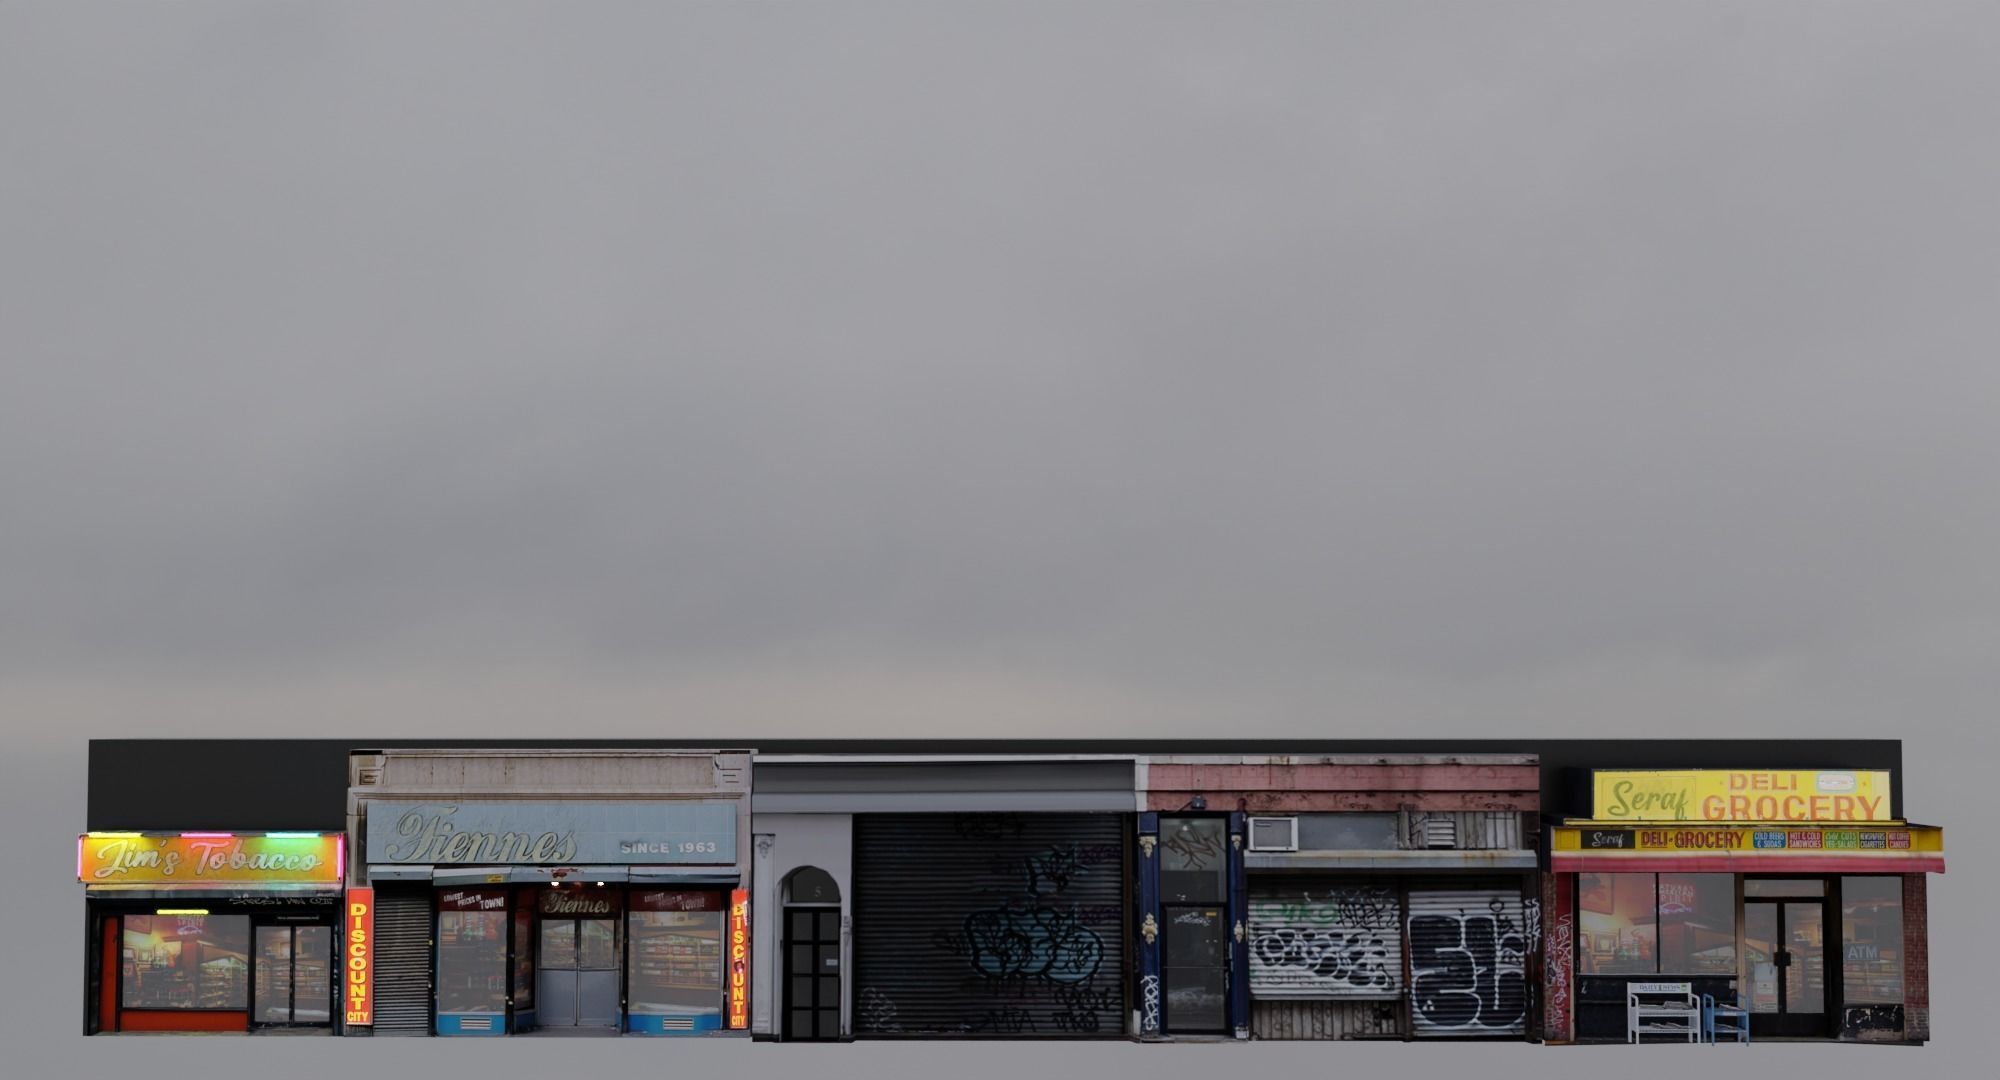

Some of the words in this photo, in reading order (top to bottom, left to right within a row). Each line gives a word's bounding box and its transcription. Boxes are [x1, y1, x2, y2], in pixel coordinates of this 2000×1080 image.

[1729, 773, 1797, 790] DELI
[1607, 780, 1688, 820] Seraf
[1702, 795, 1882, 820] GROCERY
[385, 804, 577, 863] Fiennes
[1591, 831, 1624, 848] Seraf
[620, 843, 669, 854] SINCE
[678, 842, 716, 853] 1963
[94, 839, 182, 878] Jim's
[191, 839, 323, 876] Tobacco
[444, 892, 464, 902] LOWEST
[480, 897, 504, 910] TOWN!
[545, 890, 609, 913] Fiennes
[349, 903, 367, 1010] DISCOUNT
[1848, 945, 1877, 958] ATM
[347, 1011, 368, 1022] CITY
[731, 1015, 745, 1026] CITY
